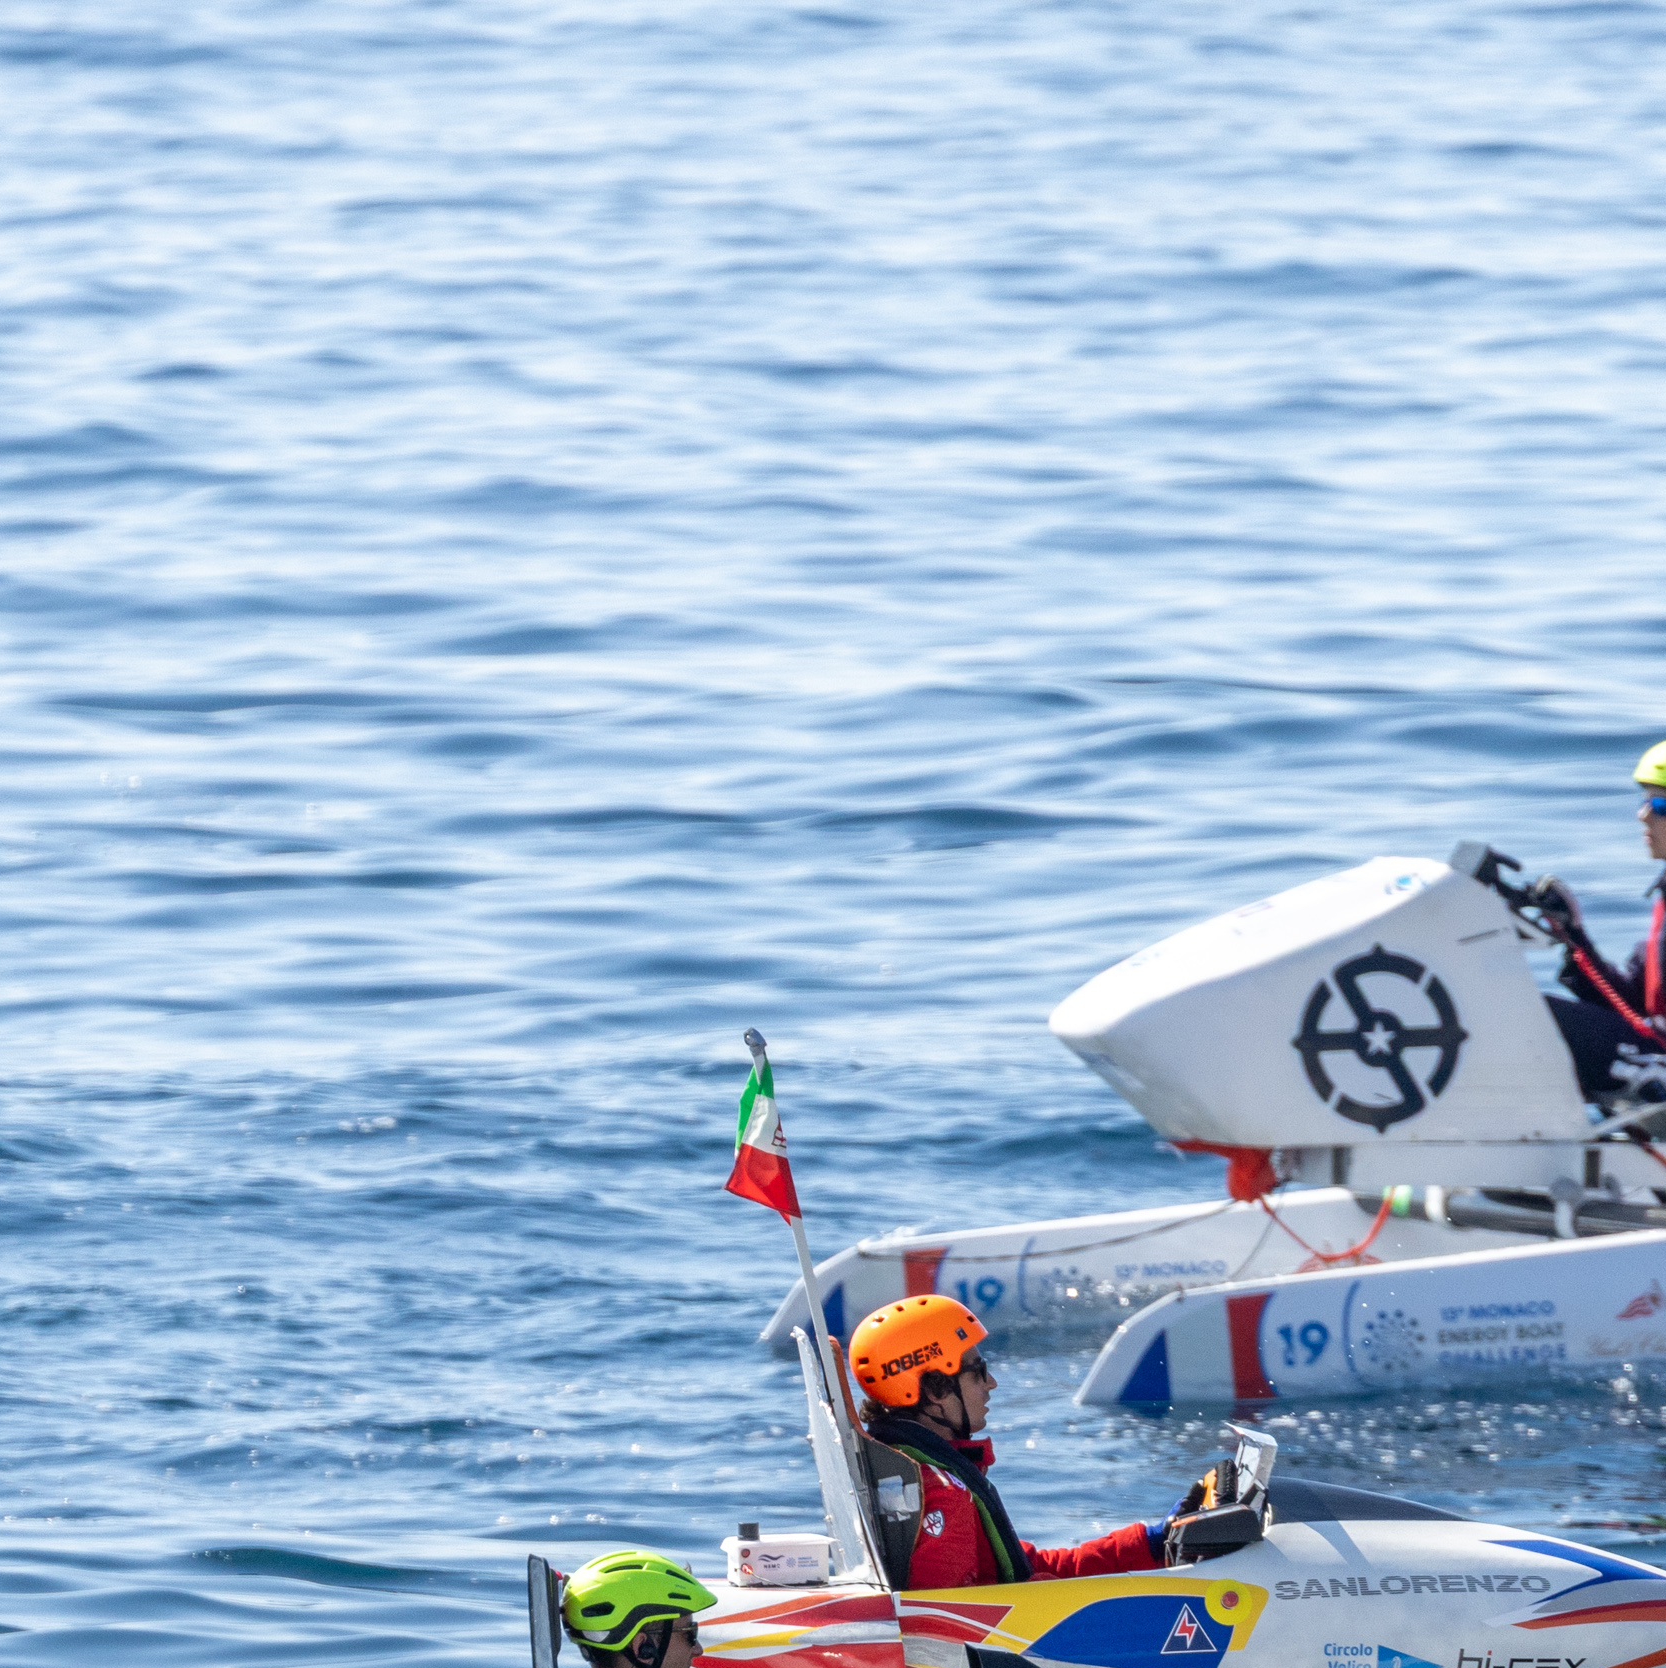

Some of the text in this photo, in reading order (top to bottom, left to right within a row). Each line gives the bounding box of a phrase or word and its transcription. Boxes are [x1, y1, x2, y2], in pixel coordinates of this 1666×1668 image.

[1141, 1259, 1228, 1277] MONACO
[954, 1277, 1005, 1308] 19
[1468, 1300, 1556, 1320] MONACO
[1277, 1319, 1329, 1367] 19
[1438, 1321, 1565, 1346] ENERGY BOAT
[881, 1347, 925, 1381] JOBE
[1439, 1343, 1567, 1366] CHALLENGE
[1275, 1573, 1551, 1600] SANLORENZO
[1323, 1643, 1373, 1657] Circolo
